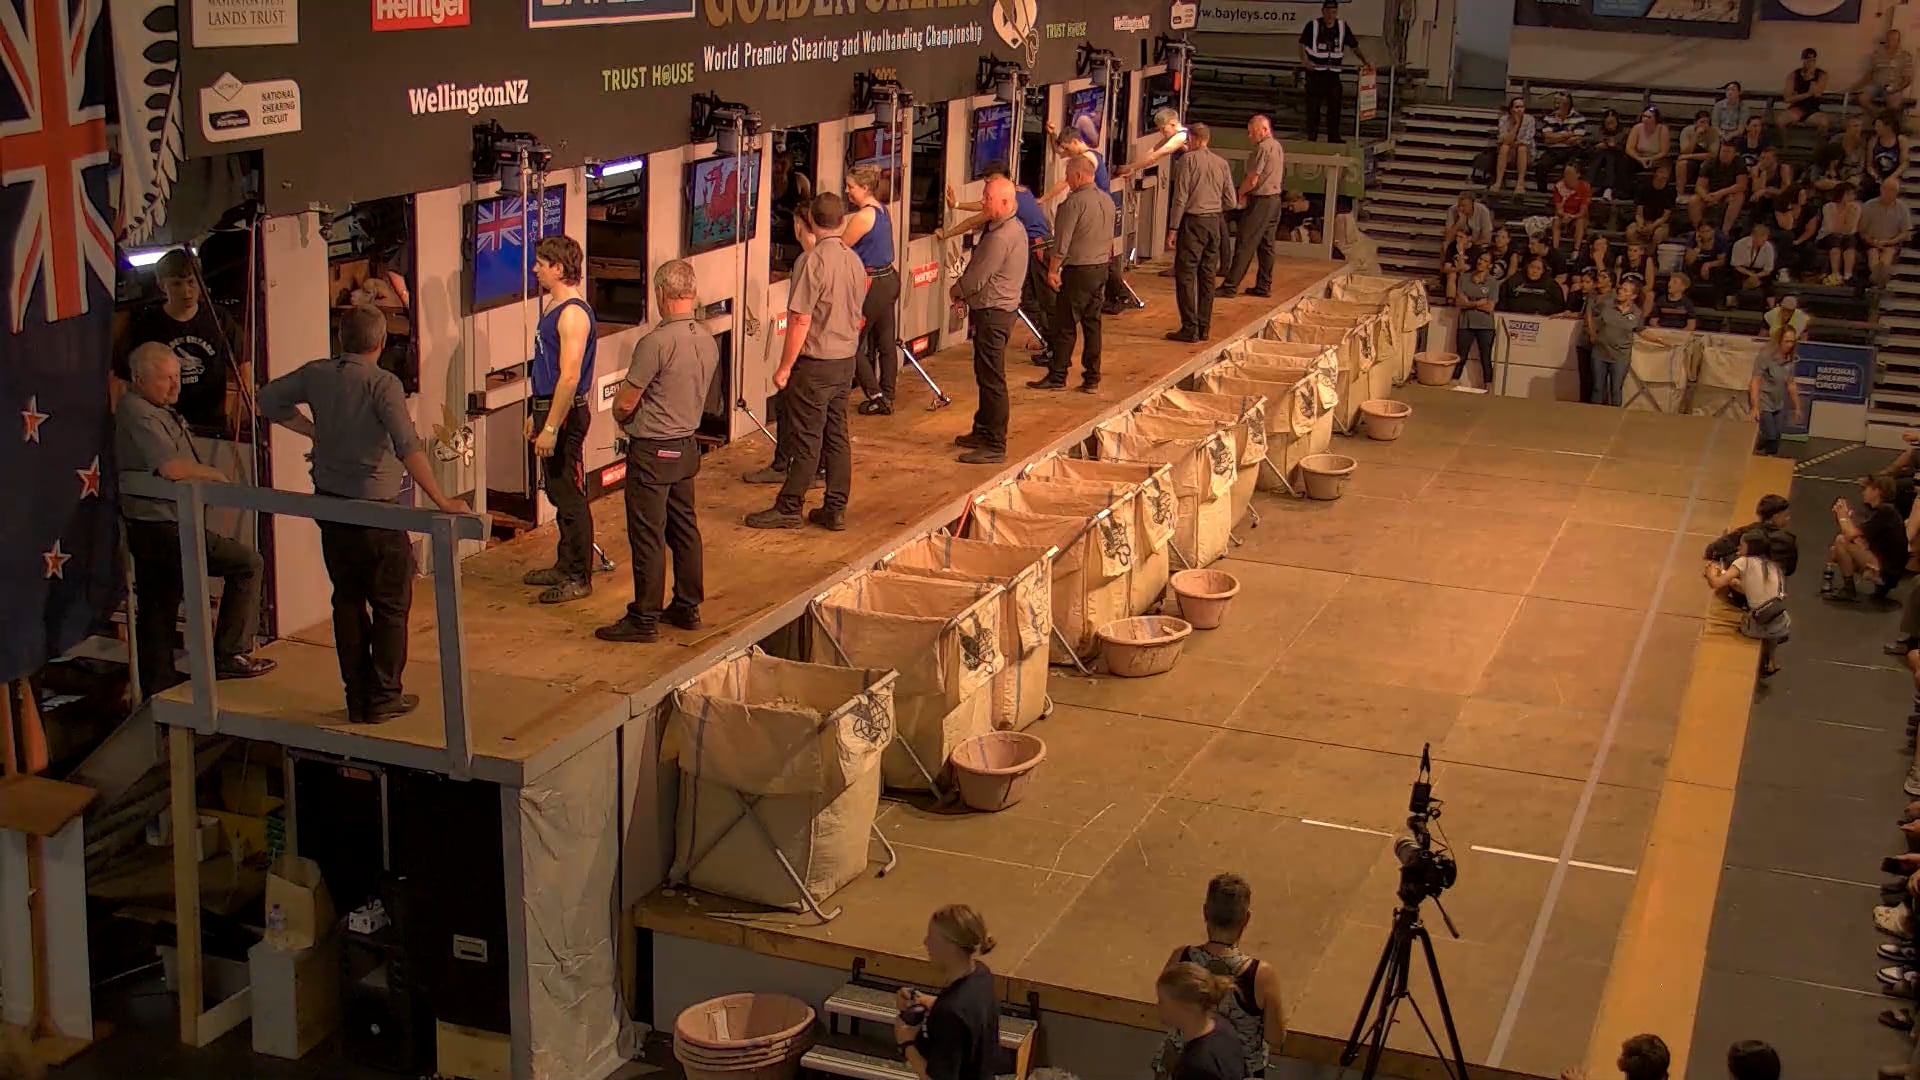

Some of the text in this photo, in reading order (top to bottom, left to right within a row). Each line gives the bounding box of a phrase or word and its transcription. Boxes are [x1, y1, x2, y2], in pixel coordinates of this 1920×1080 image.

[208, 10, 286, 25] LANDS TRUST
[703, 20, 982, 73] World Premier Shearing and Woolhandling Championship
[602, 62, 695, 92] TRUST HOUSE
[261, 89, 295, 101] NATIONAL
[408, 79, 529, 115] WellingtonNZ
[262, 113, 289, 125] CIRCUIT
